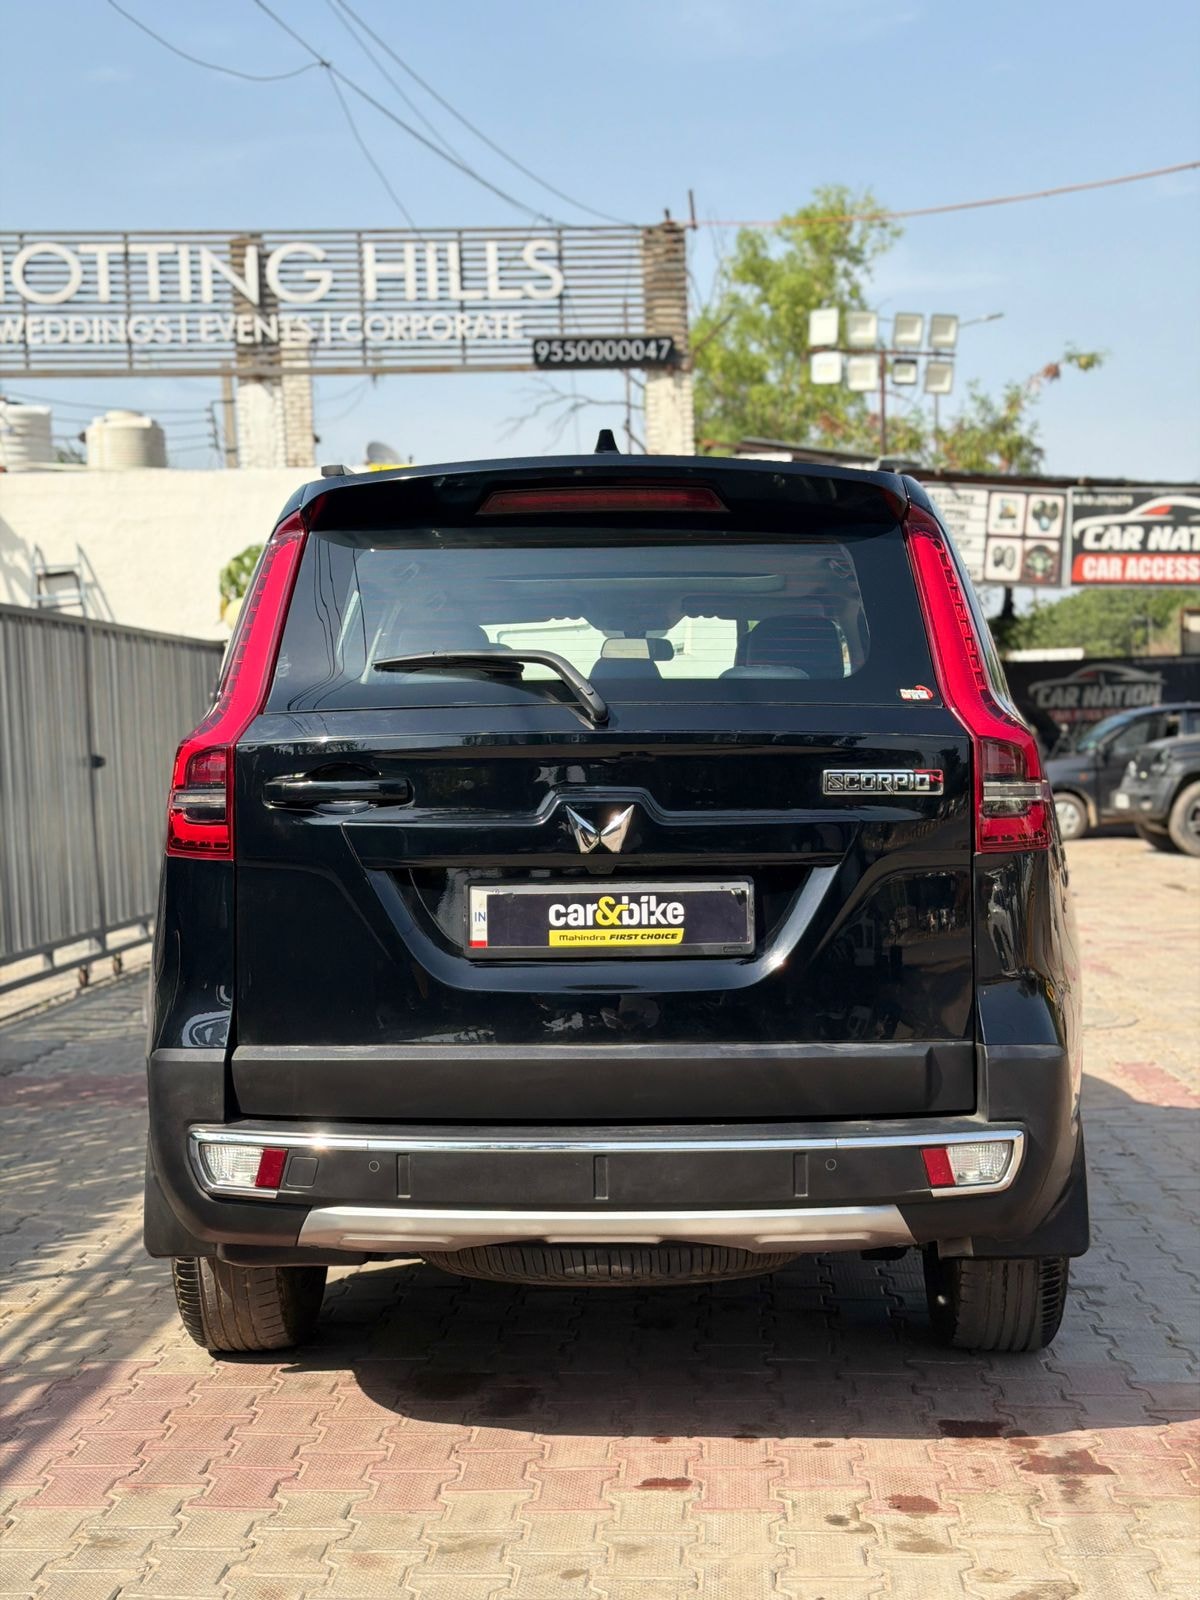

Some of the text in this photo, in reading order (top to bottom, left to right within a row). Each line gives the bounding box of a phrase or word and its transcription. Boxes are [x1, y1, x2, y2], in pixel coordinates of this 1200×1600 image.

[0, 239, 564, 305] OTTING HILLS
[0, 313, 523, 345] WEDDINGS EVENTS CORPORATE
[535, 339, 671, 362] 9550000047
[1082, 525, 1145, 551] CAR
[1082, 556, 1200, 581] CAR ACCESS
[1036, 682, 1161, 708] CAR NATION
[828, 773, 930, 794] SCORPIO
[474, 911, 487, 922] IN
[549, 895, 685, 927] car&bike
[558, 932, 678, 941] Mahindra FIRST CHOICE
